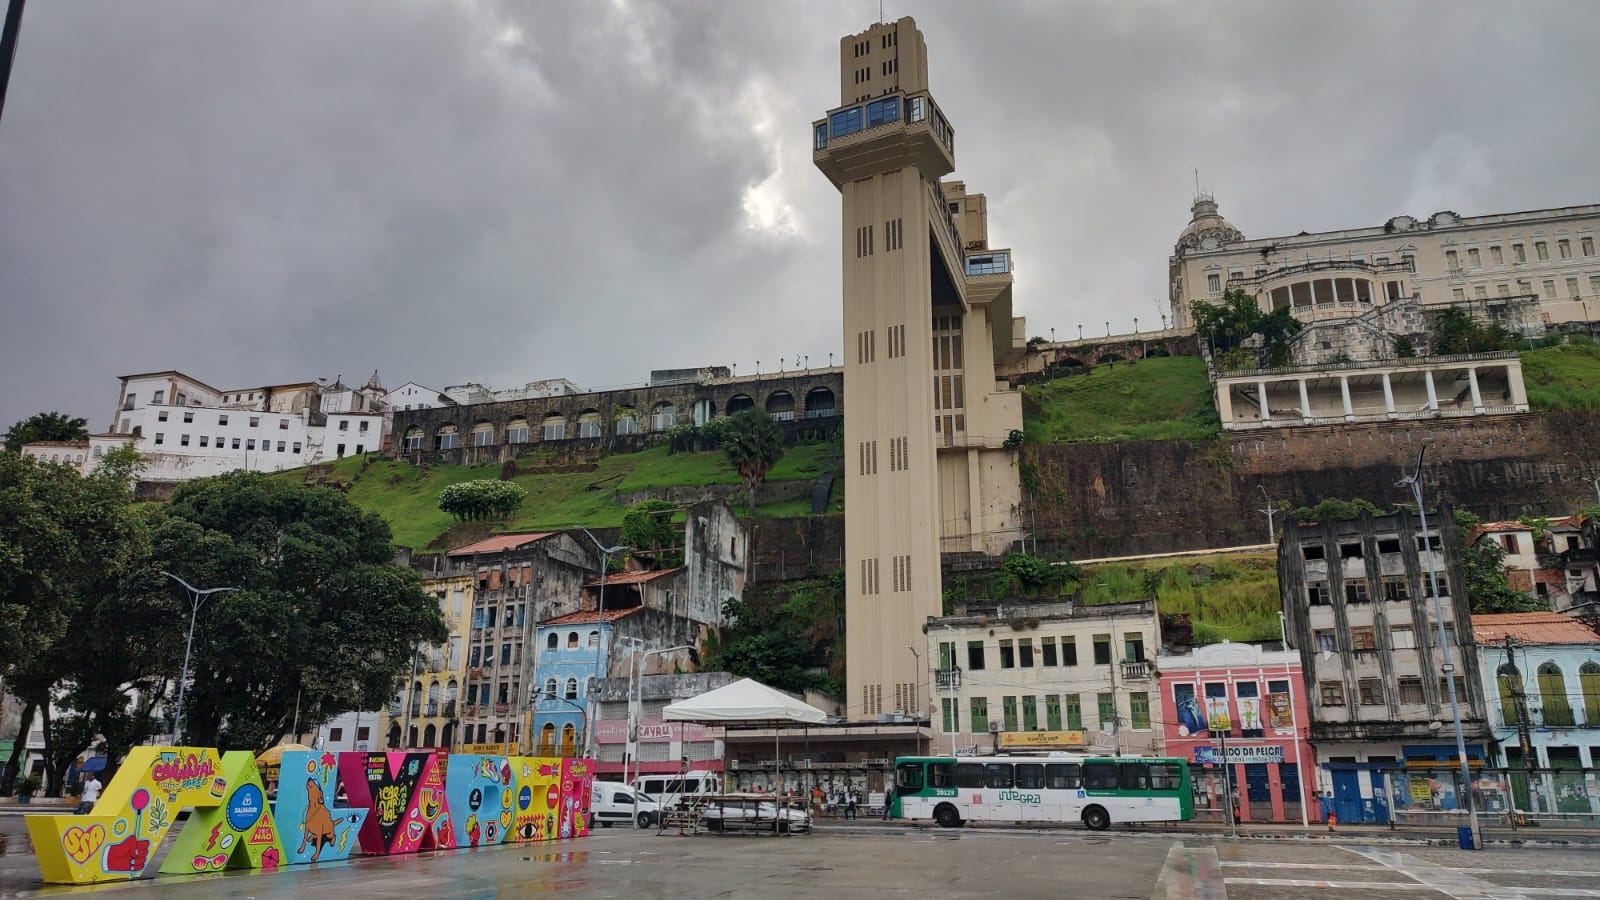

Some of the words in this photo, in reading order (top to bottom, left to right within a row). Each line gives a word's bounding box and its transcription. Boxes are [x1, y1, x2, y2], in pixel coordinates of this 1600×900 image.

[639, 726, 669, 737] CAYRU
[1242, 746, 1254, 756] DA
[64, 825, 104, 862] SSA
